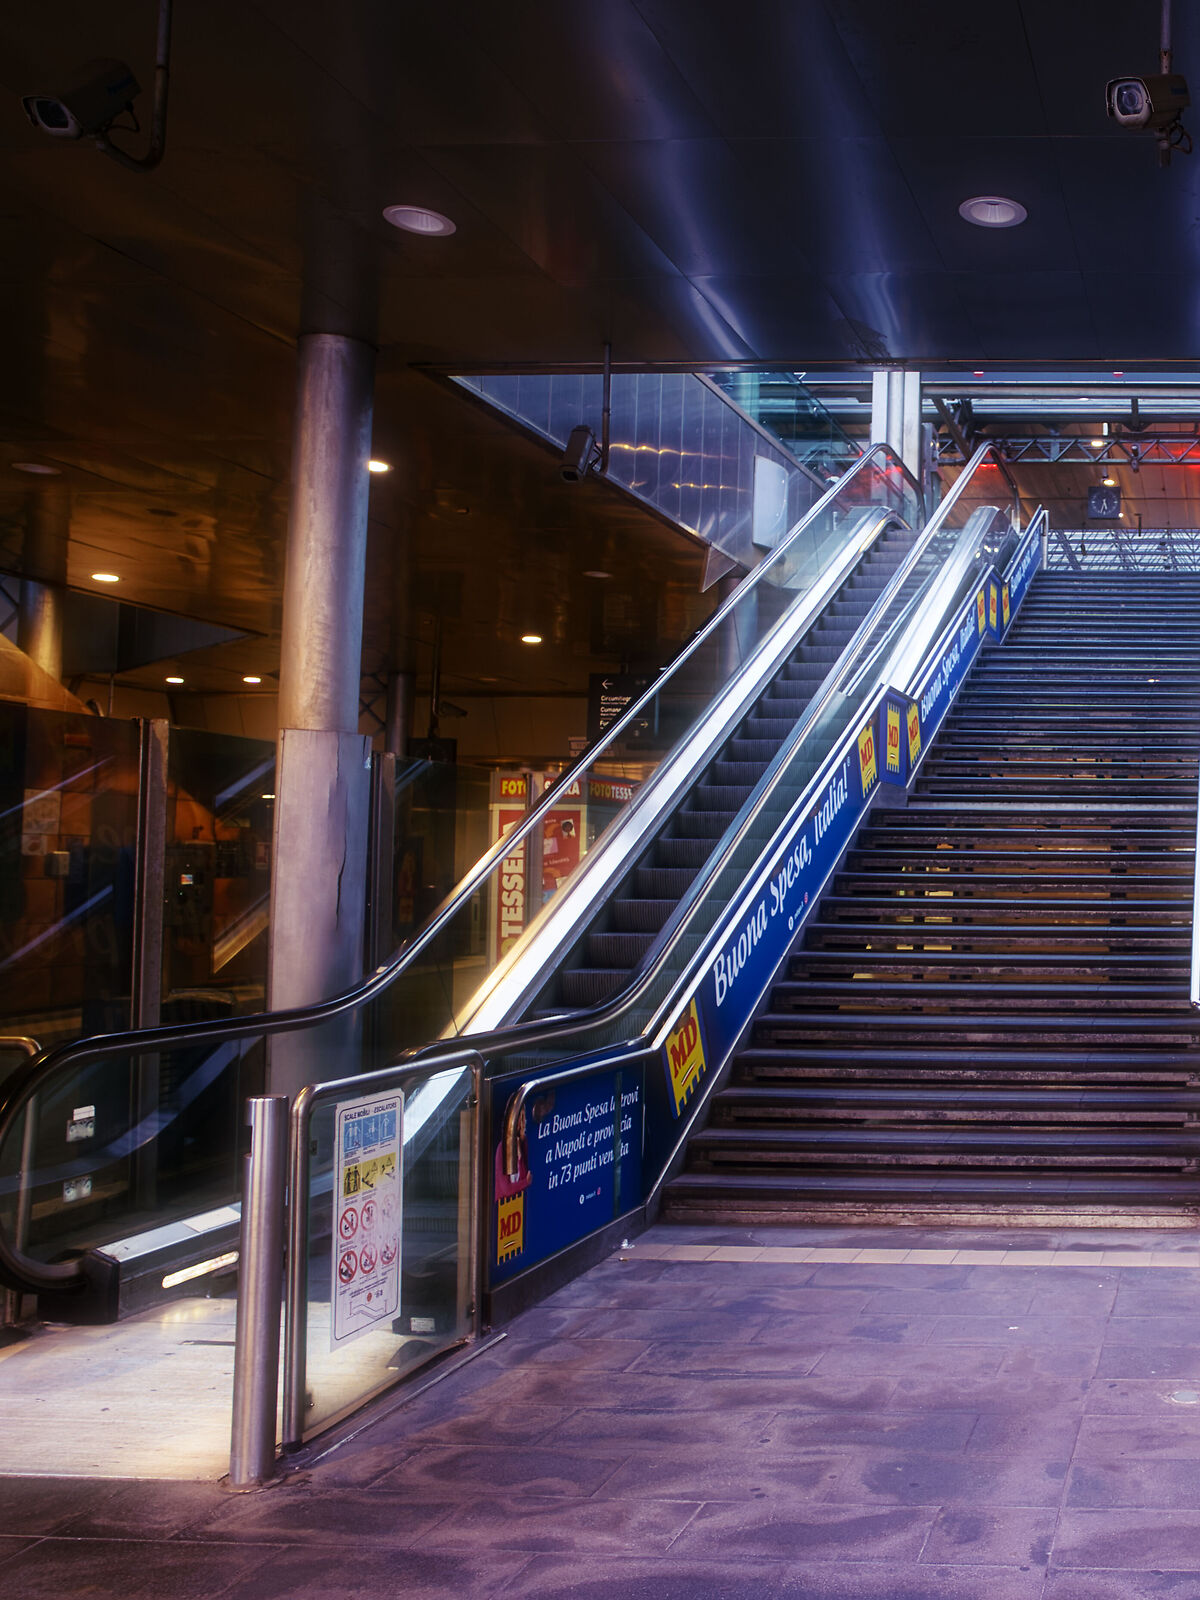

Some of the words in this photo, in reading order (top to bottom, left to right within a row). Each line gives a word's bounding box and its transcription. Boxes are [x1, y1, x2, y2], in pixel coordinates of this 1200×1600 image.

[887, 723, 898, 748] MD
[908, 715, 918, 740] MD
[860, 736, 873, 770] MD
[502, 780, 526, 795] FOT
[713, 899, 767, 1008] Buona
[814, 762, 849, 846] Italia!
[670, 1015, 698, 1078] MD
[538, 1122, 550, 1139] La
[552, 1111, 582, 1134] Buona
[584, 1103, 608, 1123] Spesa
[620, 1086, 639, 1107] trovi
[545, 1150, 552, 1163] a
[554, 1130, 586, 1161] Napoli
[587, 1133, 592, 1146] e
[593, 1114, 632, 1148] provcia
[548, 1172, 558, 1190] in
[560, 1163, 571, 1183] 73
[573, 1151, 597, 1182] punti
[599, 1142, 629, 1166] venta
[499, 1211, 521, 1240] MD
